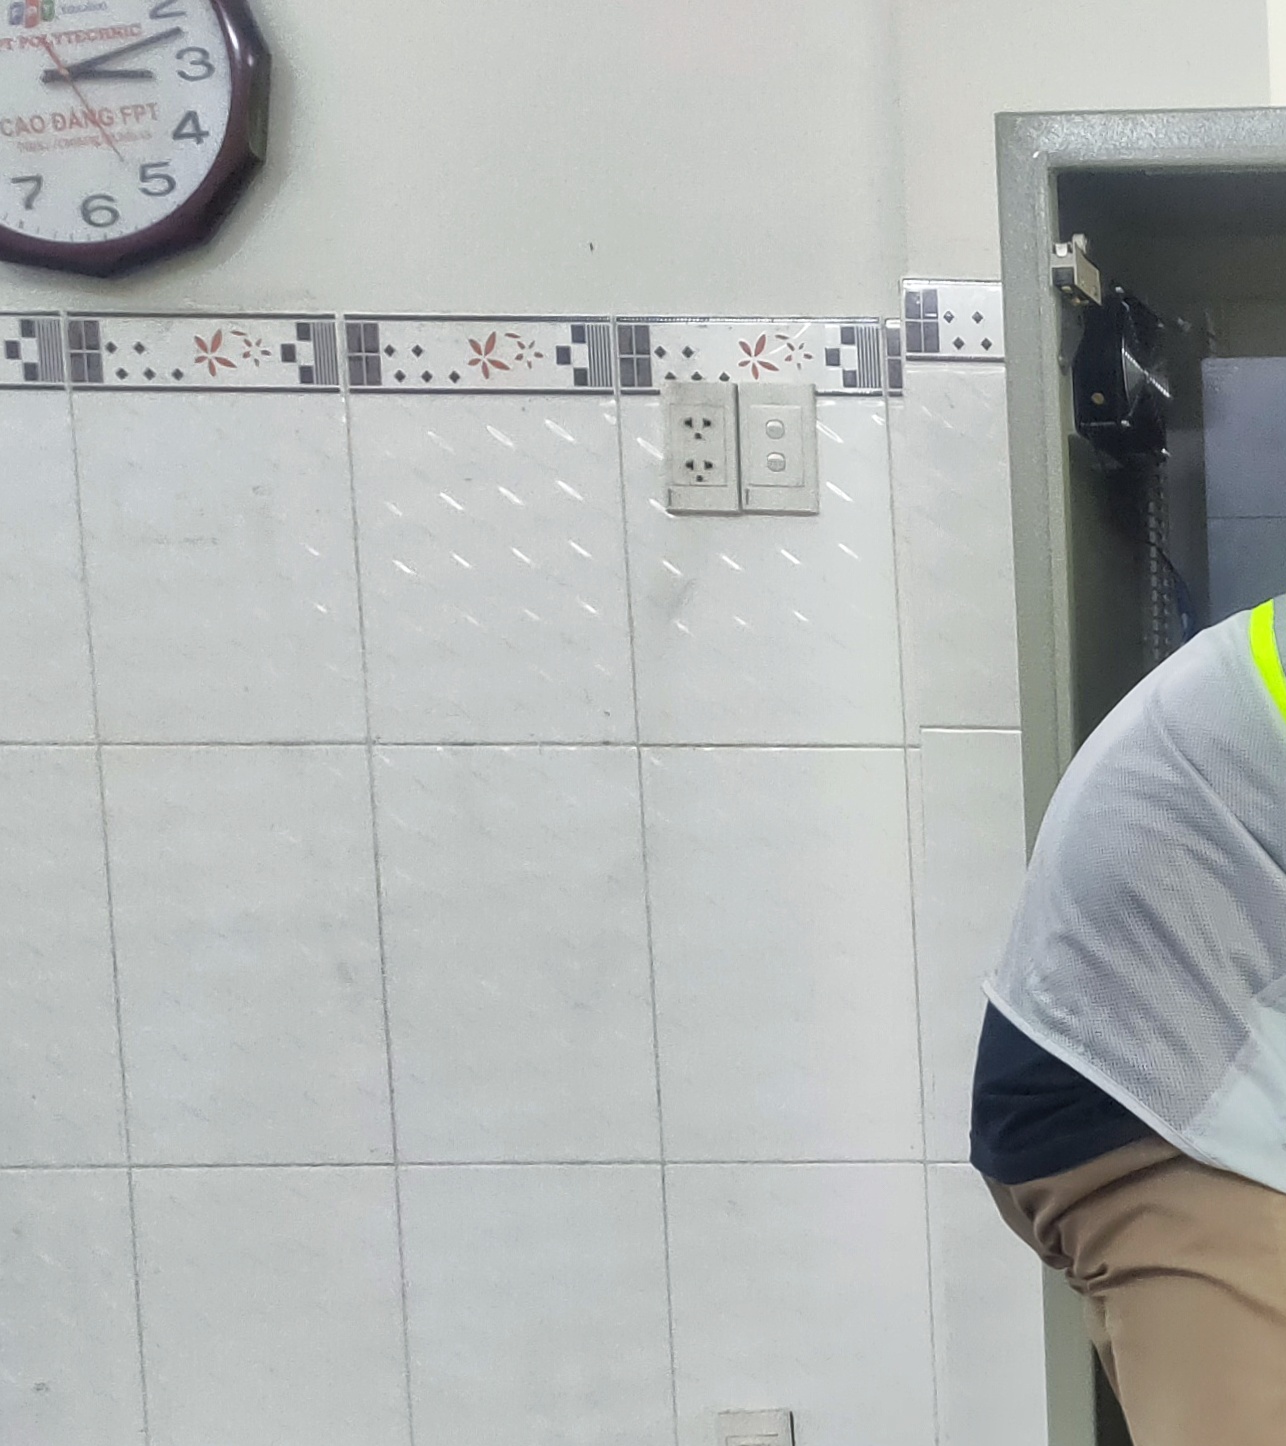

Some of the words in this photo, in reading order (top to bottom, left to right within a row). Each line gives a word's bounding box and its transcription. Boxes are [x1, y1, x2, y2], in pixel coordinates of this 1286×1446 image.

[175, 46, 215, 82] 3
[0, 113, 46, 137] CAO
[120, 103, 159, 124] FPT
[172, 109, 210, 145] 4
[11, 173, 44, 211] 7
[138, 160, 177, 197] 5
[80, 193, 121, 228] 6
